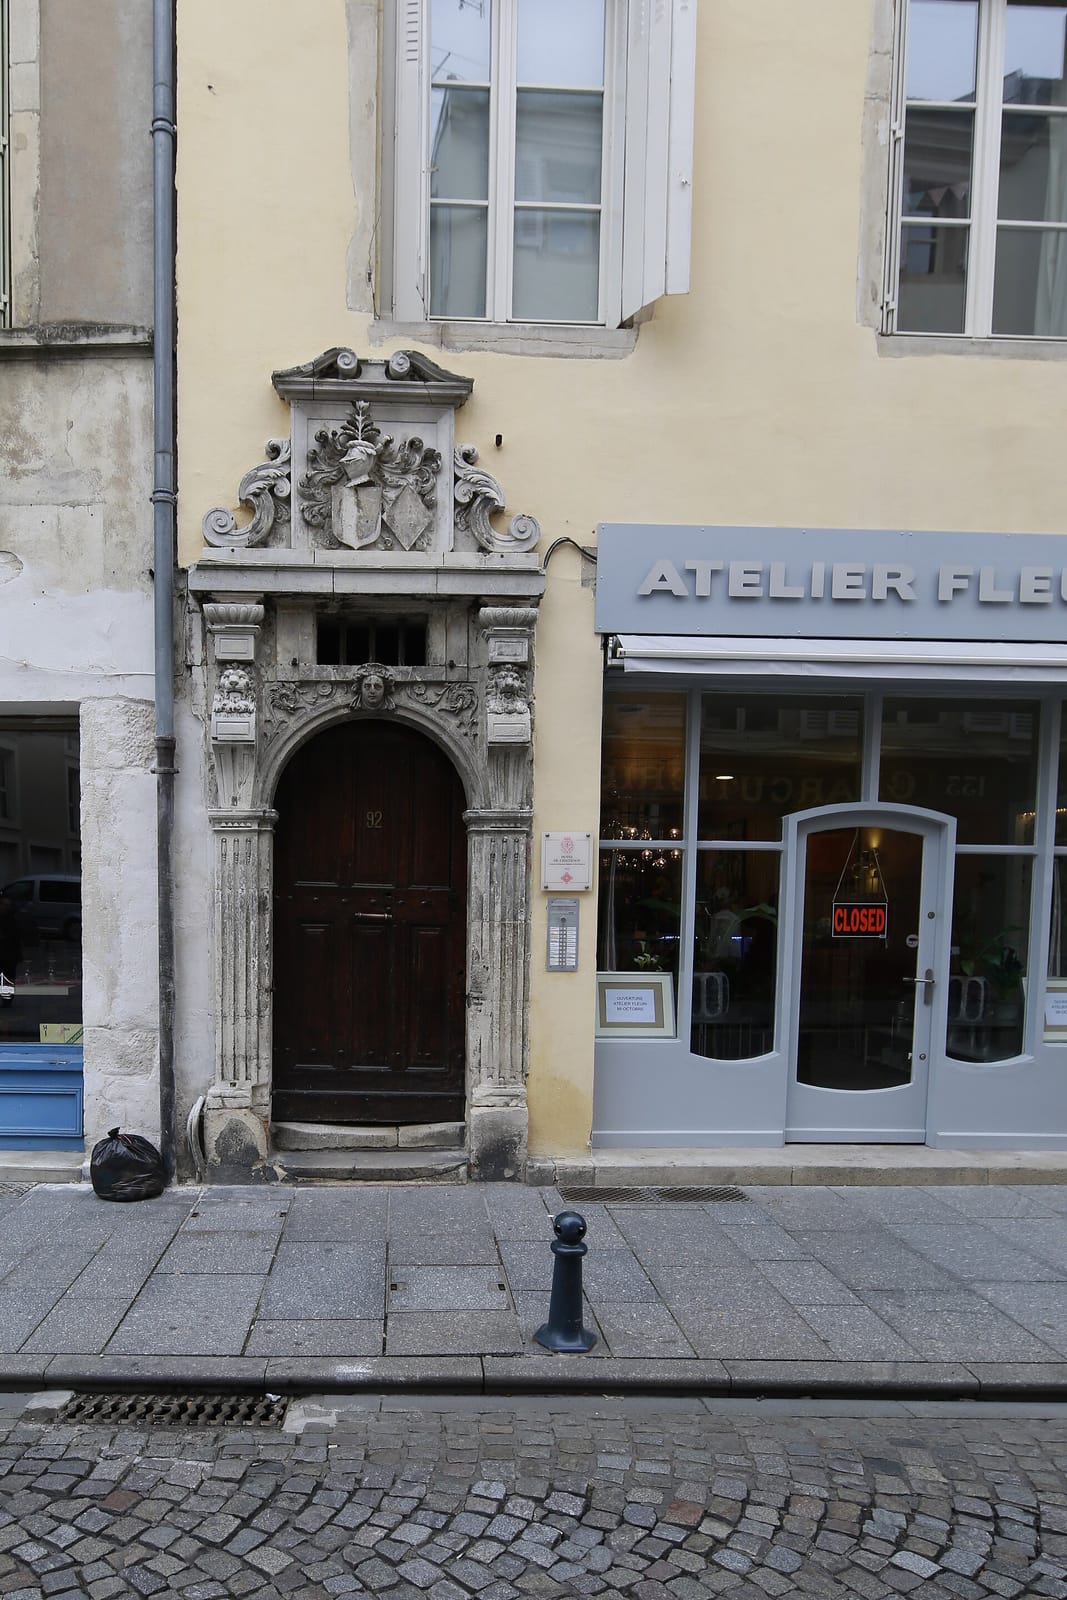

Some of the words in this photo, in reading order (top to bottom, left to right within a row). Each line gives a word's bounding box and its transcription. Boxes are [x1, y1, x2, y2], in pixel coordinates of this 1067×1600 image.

[637, 559, 917, 601] ATELIER
[938, 564, 1067, 603] FLE
[366, 811, 383, 829] 92
[834, 908, 885, 932] CLOSED
